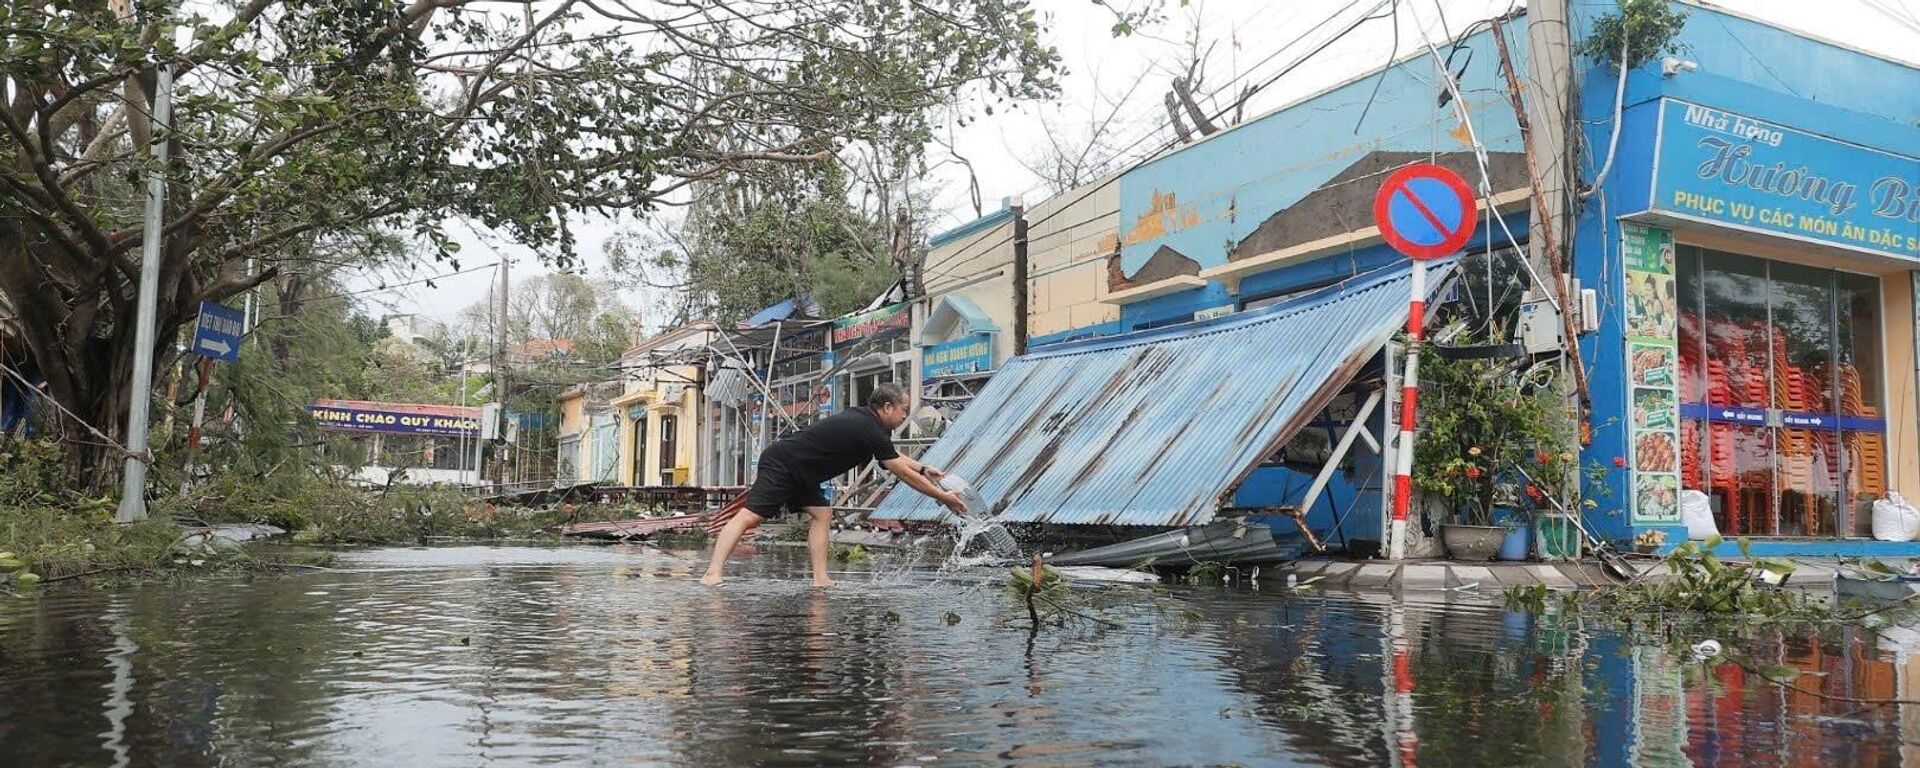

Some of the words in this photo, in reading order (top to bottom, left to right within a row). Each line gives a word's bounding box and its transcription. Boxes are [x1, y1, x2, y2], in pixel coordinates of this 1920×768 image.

[1684, 104, 1728, 130] Nhà
[1733, 117, 1784, 147] hàng
[1697, 135, 1857, 216] Hương
[1674, 191, 1724, 217] PHỤC
[1731, 201, 1754, 224] VỤ
[1759, 206, 1794, 228] CÁC
[1799, 214, 1837, 236] MÓN
[1841, 220, 1865, 241] ĂN
[1869, 227, 1903, 250] ĐẶC
[1907, 236, 1920, 251] S
[313, 409, 351, 422] KÍNH
[356, 412, 396, 425] CHÀO
[400, 415, 430, 427] QUÝ
